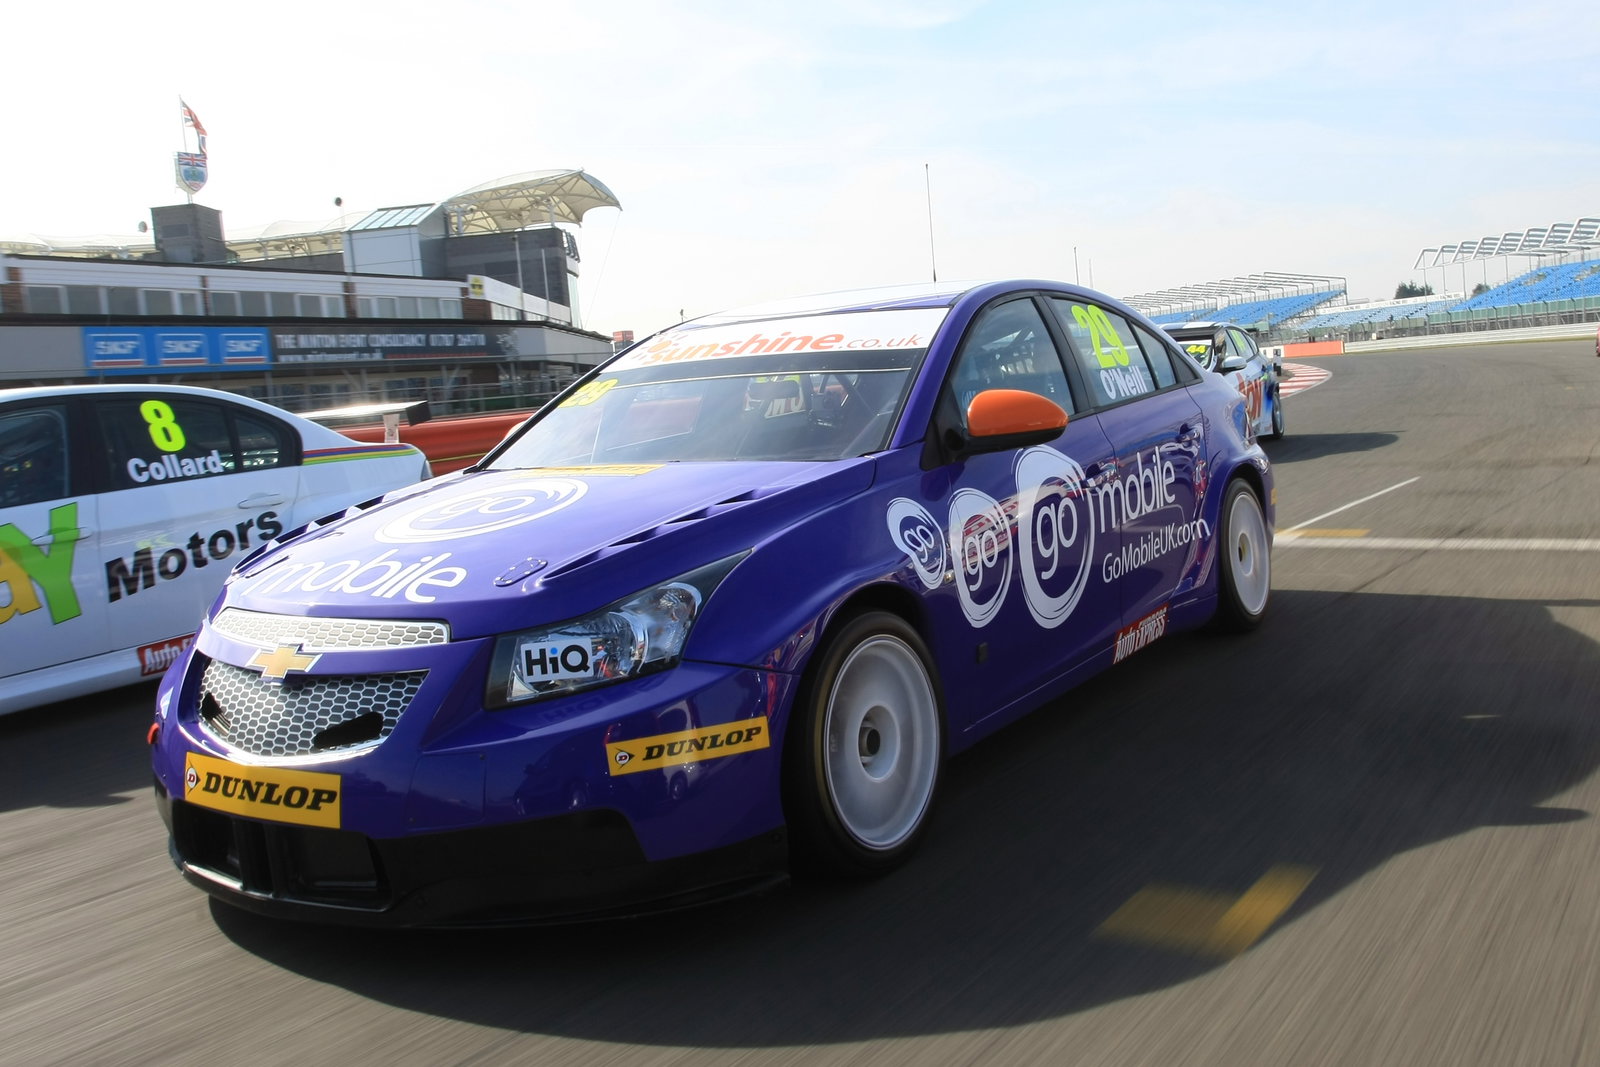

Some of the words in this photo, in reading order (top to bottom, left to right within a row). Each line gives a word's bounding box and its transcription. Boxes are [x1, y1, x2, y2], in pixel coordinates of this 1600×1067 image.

[95, 341, 140, 354] SKF
[163, 340, 203, 354] SKF
[226, 339, 263, 352] SKF
[276, 334, 297, 348] THE
[642, 331, 923, 365] sunshine.co.uk
[1071, 304, 1130, 369] 29
[1184, 345, 1207, 354] 44
[1100, 365, 1148, 401] O'Neill
[139, 400, 187, 452] 8
[127, 450, 224, 484] Collard
[1097, 446, 1176, 534] mobile
[105, 510, 283, 603] Motors
[904, 523, 935, 563] go
[1036, 497, 1078, 580] go
[1102, 518, 1211, 584] GoMobileUK.com
[242, 549, 468, 603] mobile
[965, 529, 999, 592] go
[524, 645, 591, 677] HiQ
[642, 726, 762, 761] DUNLOP
[202, 772, 338, 811] DUNLOP
